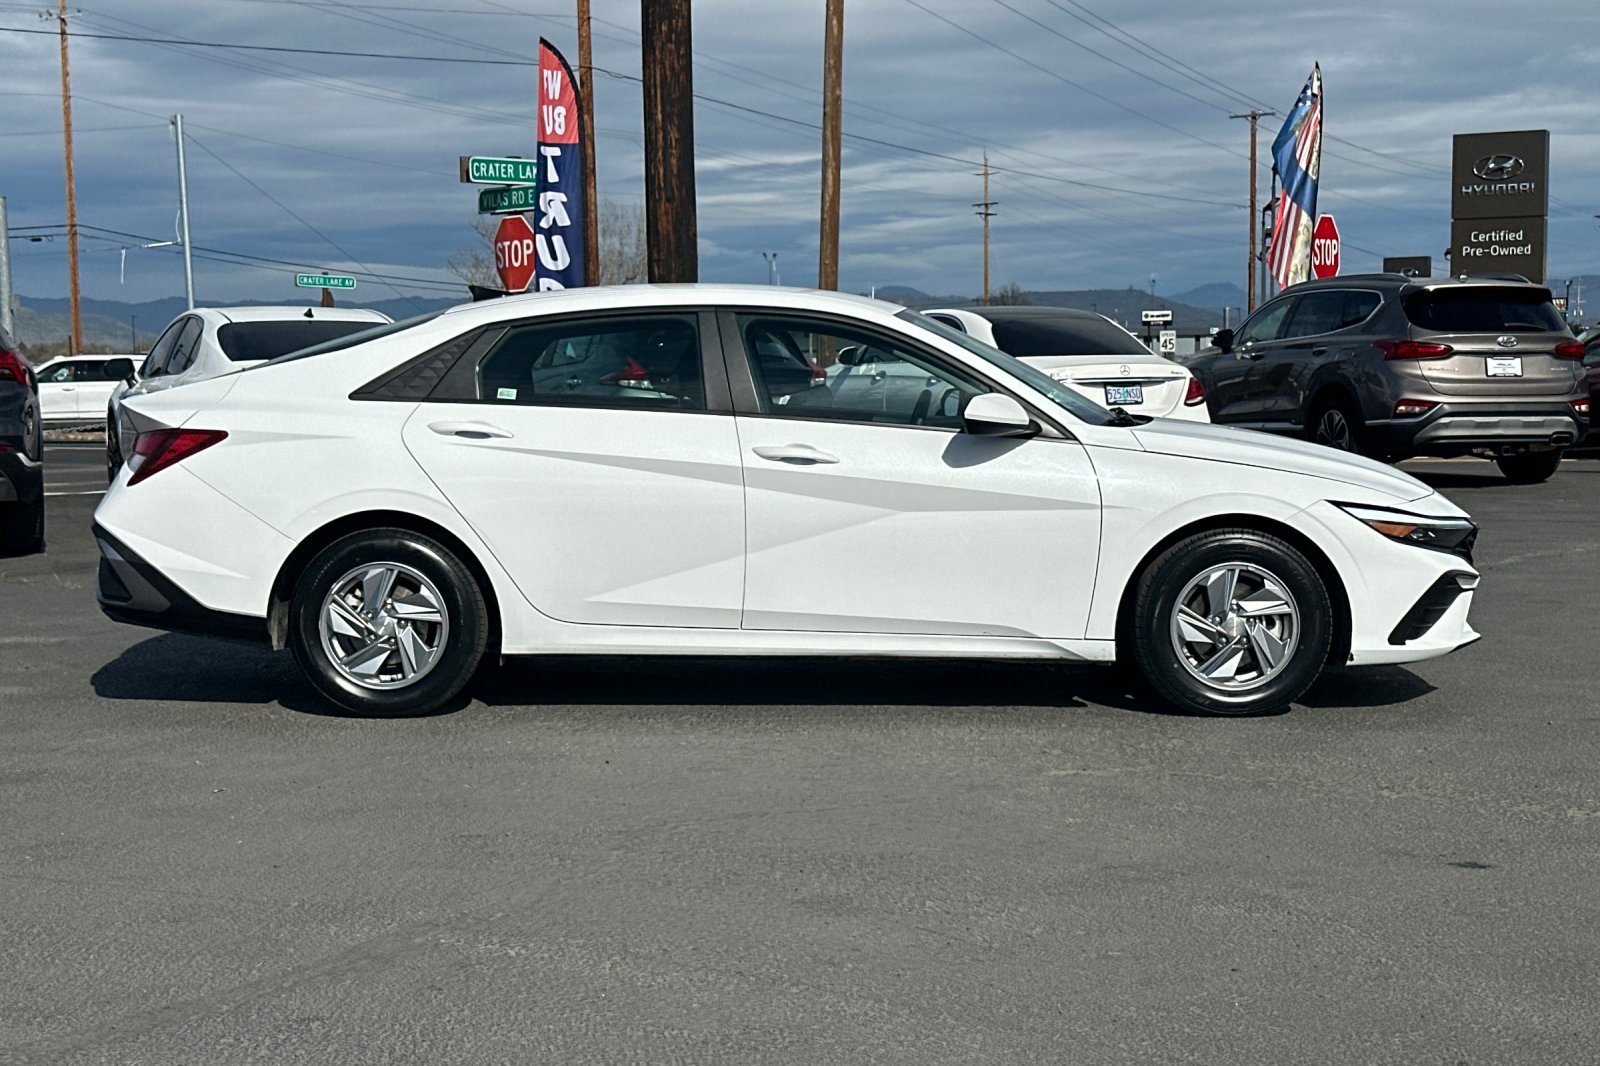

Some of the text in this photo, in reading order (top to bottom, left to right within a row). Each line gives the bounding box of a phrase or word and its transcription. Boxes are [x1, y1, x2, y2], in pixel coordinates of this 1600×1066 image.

[473, 162, 515, 179] CRATER
[1461, 182, 1535, 197] HYUNDAI
[482, 191, 509, 209] VILAS
[512, 190, 525, 204] RD
[1470, 230, 1524, 243] Certified
[496, 239, 534, 269] STOP
[1313, 238, 1338, 266] STOP
[1462, 244, 1532, 257] Pre-Owned
[299, 276, 325, 285] CRATER
[326, 278, 343, 287] LAKE
[1161, 338, 1175, 351] 45
[1107, 388, 1122, 400] 525
